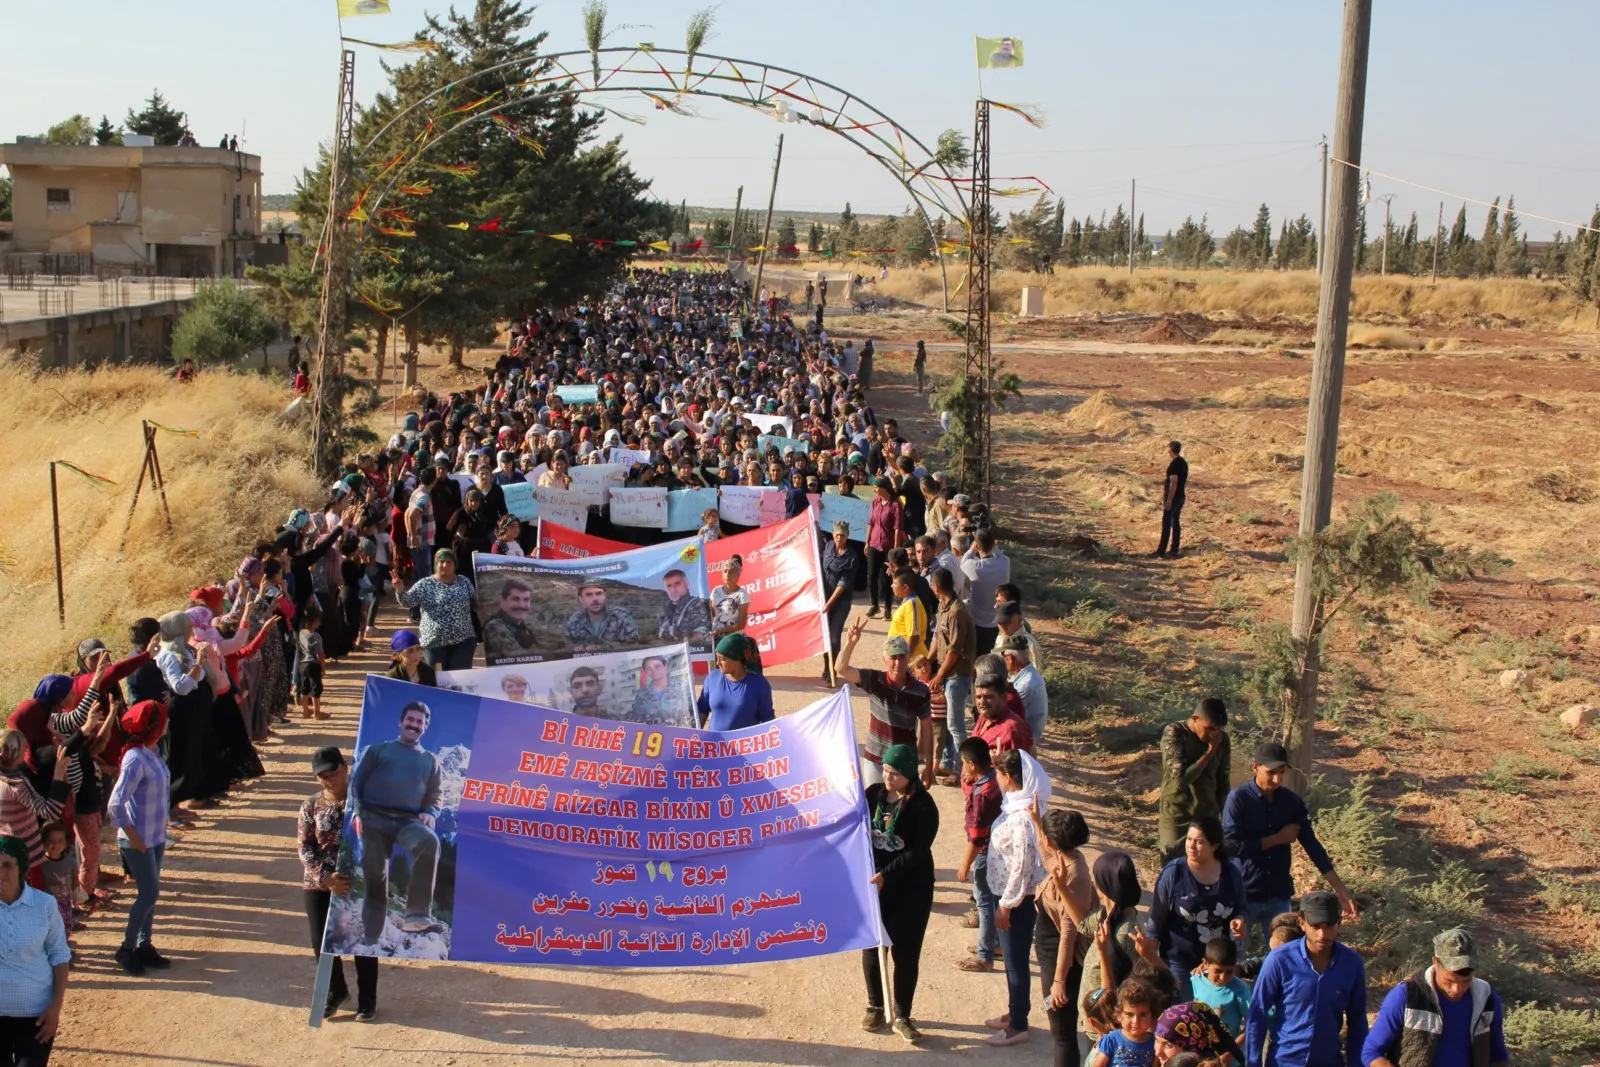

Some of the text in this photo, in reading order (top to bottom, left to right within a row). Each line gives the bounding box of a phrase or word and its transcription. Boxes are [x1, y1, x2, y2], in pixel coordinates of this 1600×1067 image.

[631, 730, 664, 759] 19
[673, 725, 781, 759] TÊRMEHÊ
[518, 751, 569, 777] EMÊ
[571, 758, 667, 788] FAŞÎZMÊ
[674, 765, 721, 788] TÊK
[462, 778, 549, 810] EFRÎNÊ
[719, 794, 734, 818] Û
[592, 860, 727, 887] بروح ١٩ تموز
[533, 889, 801, 921] سنهزم الفاشية ونحرر عفرين
[495, 919, 827, 956] ونضمن الإدارة الذاتية الديمقراطية
